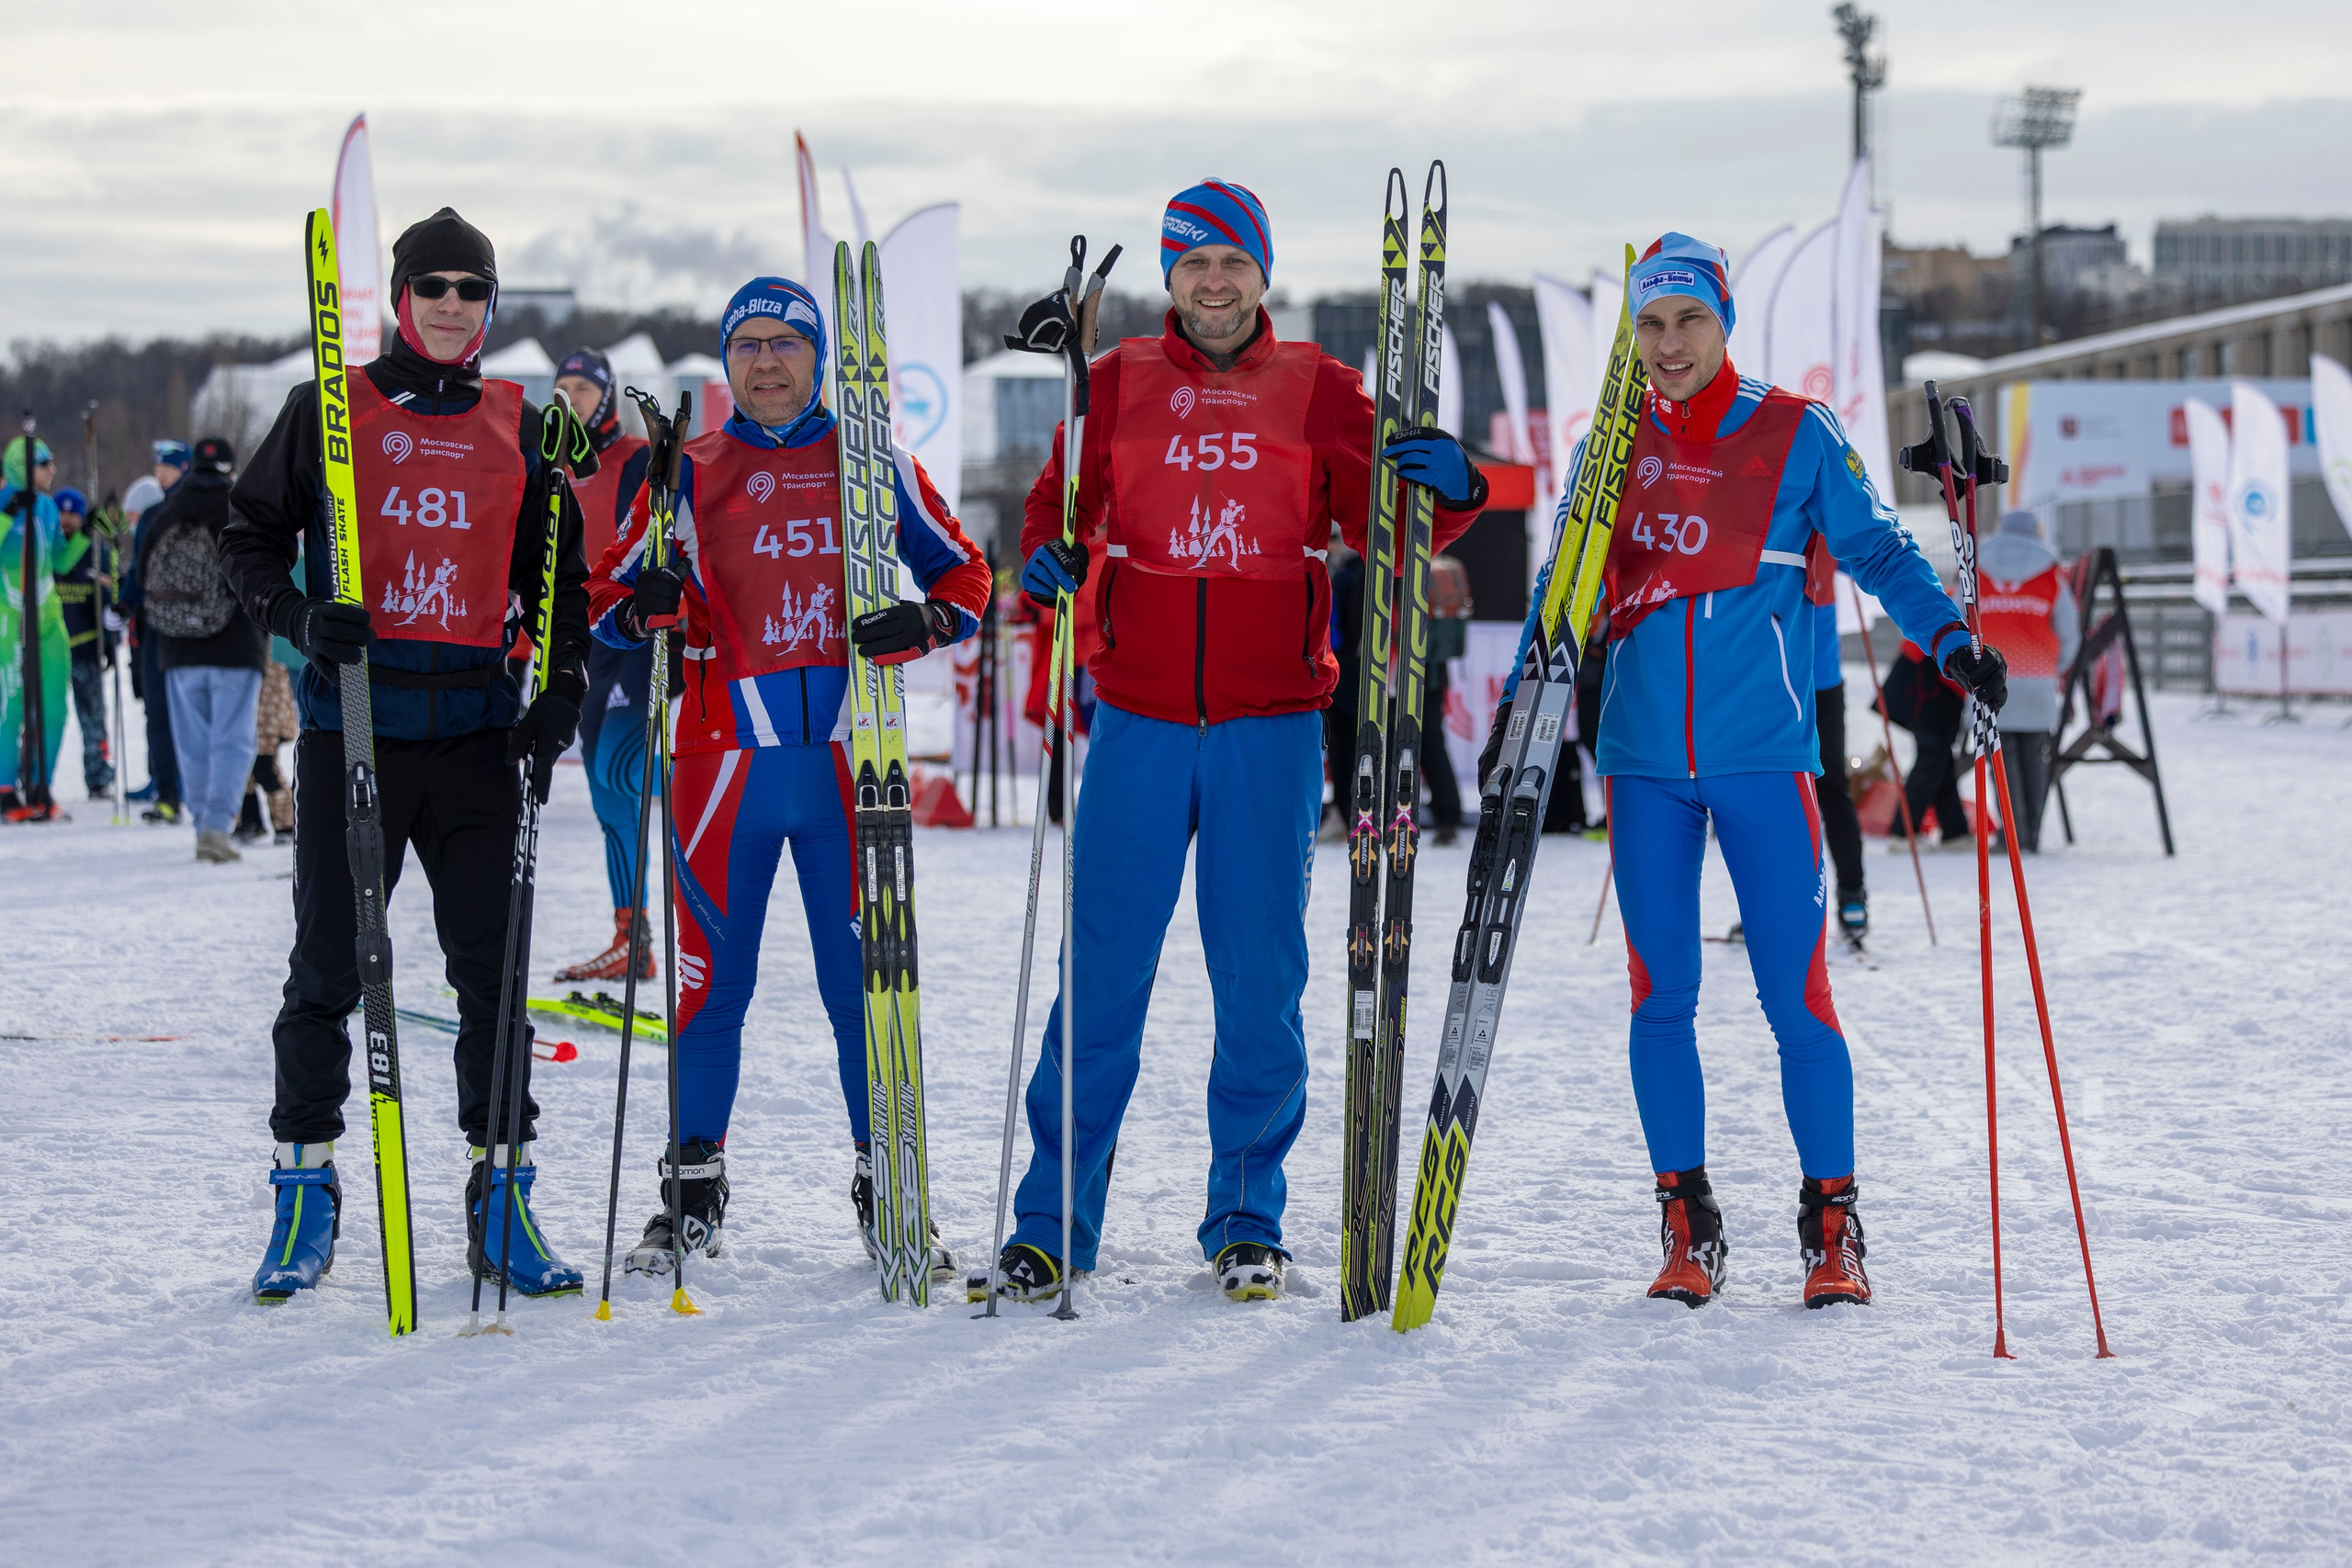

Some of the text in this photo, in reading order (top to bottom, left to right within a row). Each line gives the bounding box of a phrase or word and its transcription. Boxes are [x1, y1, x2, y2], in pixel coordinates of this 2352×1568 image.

[1386, 277, 1406, 402] FISCHER
[1424, 270, 1444, 396] FISCHER
[316, 279, 350, 466] BRADOS
[1201, 388, 1258, 401] Московский
[1201, 397, 1248, 407] транспорт
[419, 437, 474, 451] Московский
[419, 448, 465, 459] транспорт
[1164, 432, 1259, 471] 455
[1570, 354, 1627, 525] FISCHER
[1596, 358, 1649, 531] FISCHER
[782, 470, 835, 480] Московский
[782, 480, 827, 491] транспорт
[1666, 472, 1711, 485] транспорт
[1668, 462, 1724, 479] Московский
[380, 486, 472, 530] 481
[843, 385, 874, 604] FISCHER
[870, 386, 900, 606] FISCHER
[336, 497, 351, 592] FLASH SKATE
[752, 516, 842, 559] 451
[1632, 512, 1709, 556] 430
[1971, 634, 1981, 660] WORLD
[370, 1030, 390, 1086] 183
[871, 1079, 889, 1147] SKATING
[899, 1079, 918, 1148] SKATING
